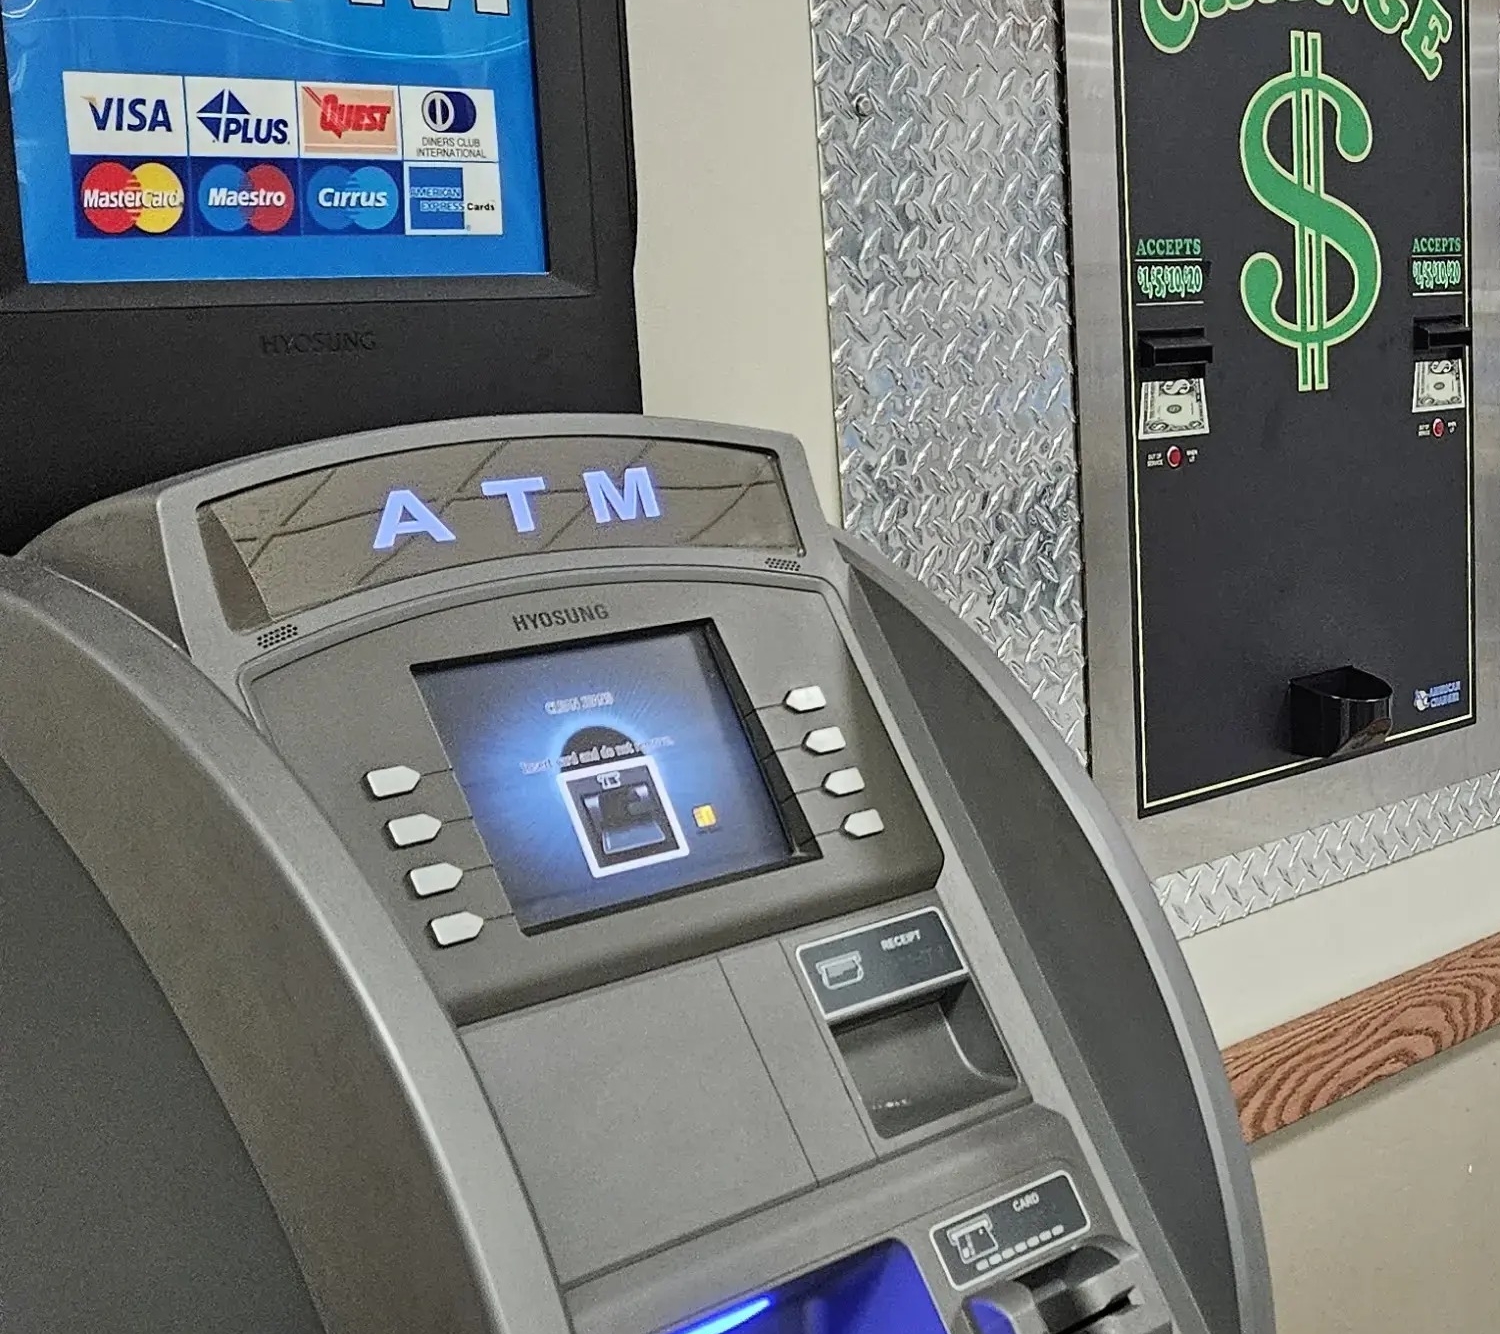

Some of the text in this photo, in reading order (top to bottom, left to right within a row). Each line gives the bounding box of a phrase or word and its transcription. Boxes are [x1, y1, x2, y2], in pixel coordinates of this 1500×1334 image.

[81, 95, 173, 133] VISA
[319, 93, 392, 139] QUEST
[222, 116, 290, 145] PLUS
[421, 136, 481, 148] DINERS CLUB
[416, 148, 487, 159] INTERNATIONAL
[83, 187, 183, 209] MasterCard
[207, 186, 286, 208] Maestro
[318, 186, 389, 208] Cirrus
[409, 186, 461, 199] AMERICAN
[420, 200, 496, 212] EXPRESS Cards
[1239, 29, 1383, 394] $
[1135, 237, 1202, 256] ACCEPTS
[1412, 236, 1462, 253] ACCEPTS
[260, 330, 376, 355] HYOSUNG
[373, 467, 661, 550] ATM
[513, 603, 610, 633] HYOSUNG
[880, 929, 921, 952] RECEIPT
[1012, 1191, 1040, 1213] CARD
